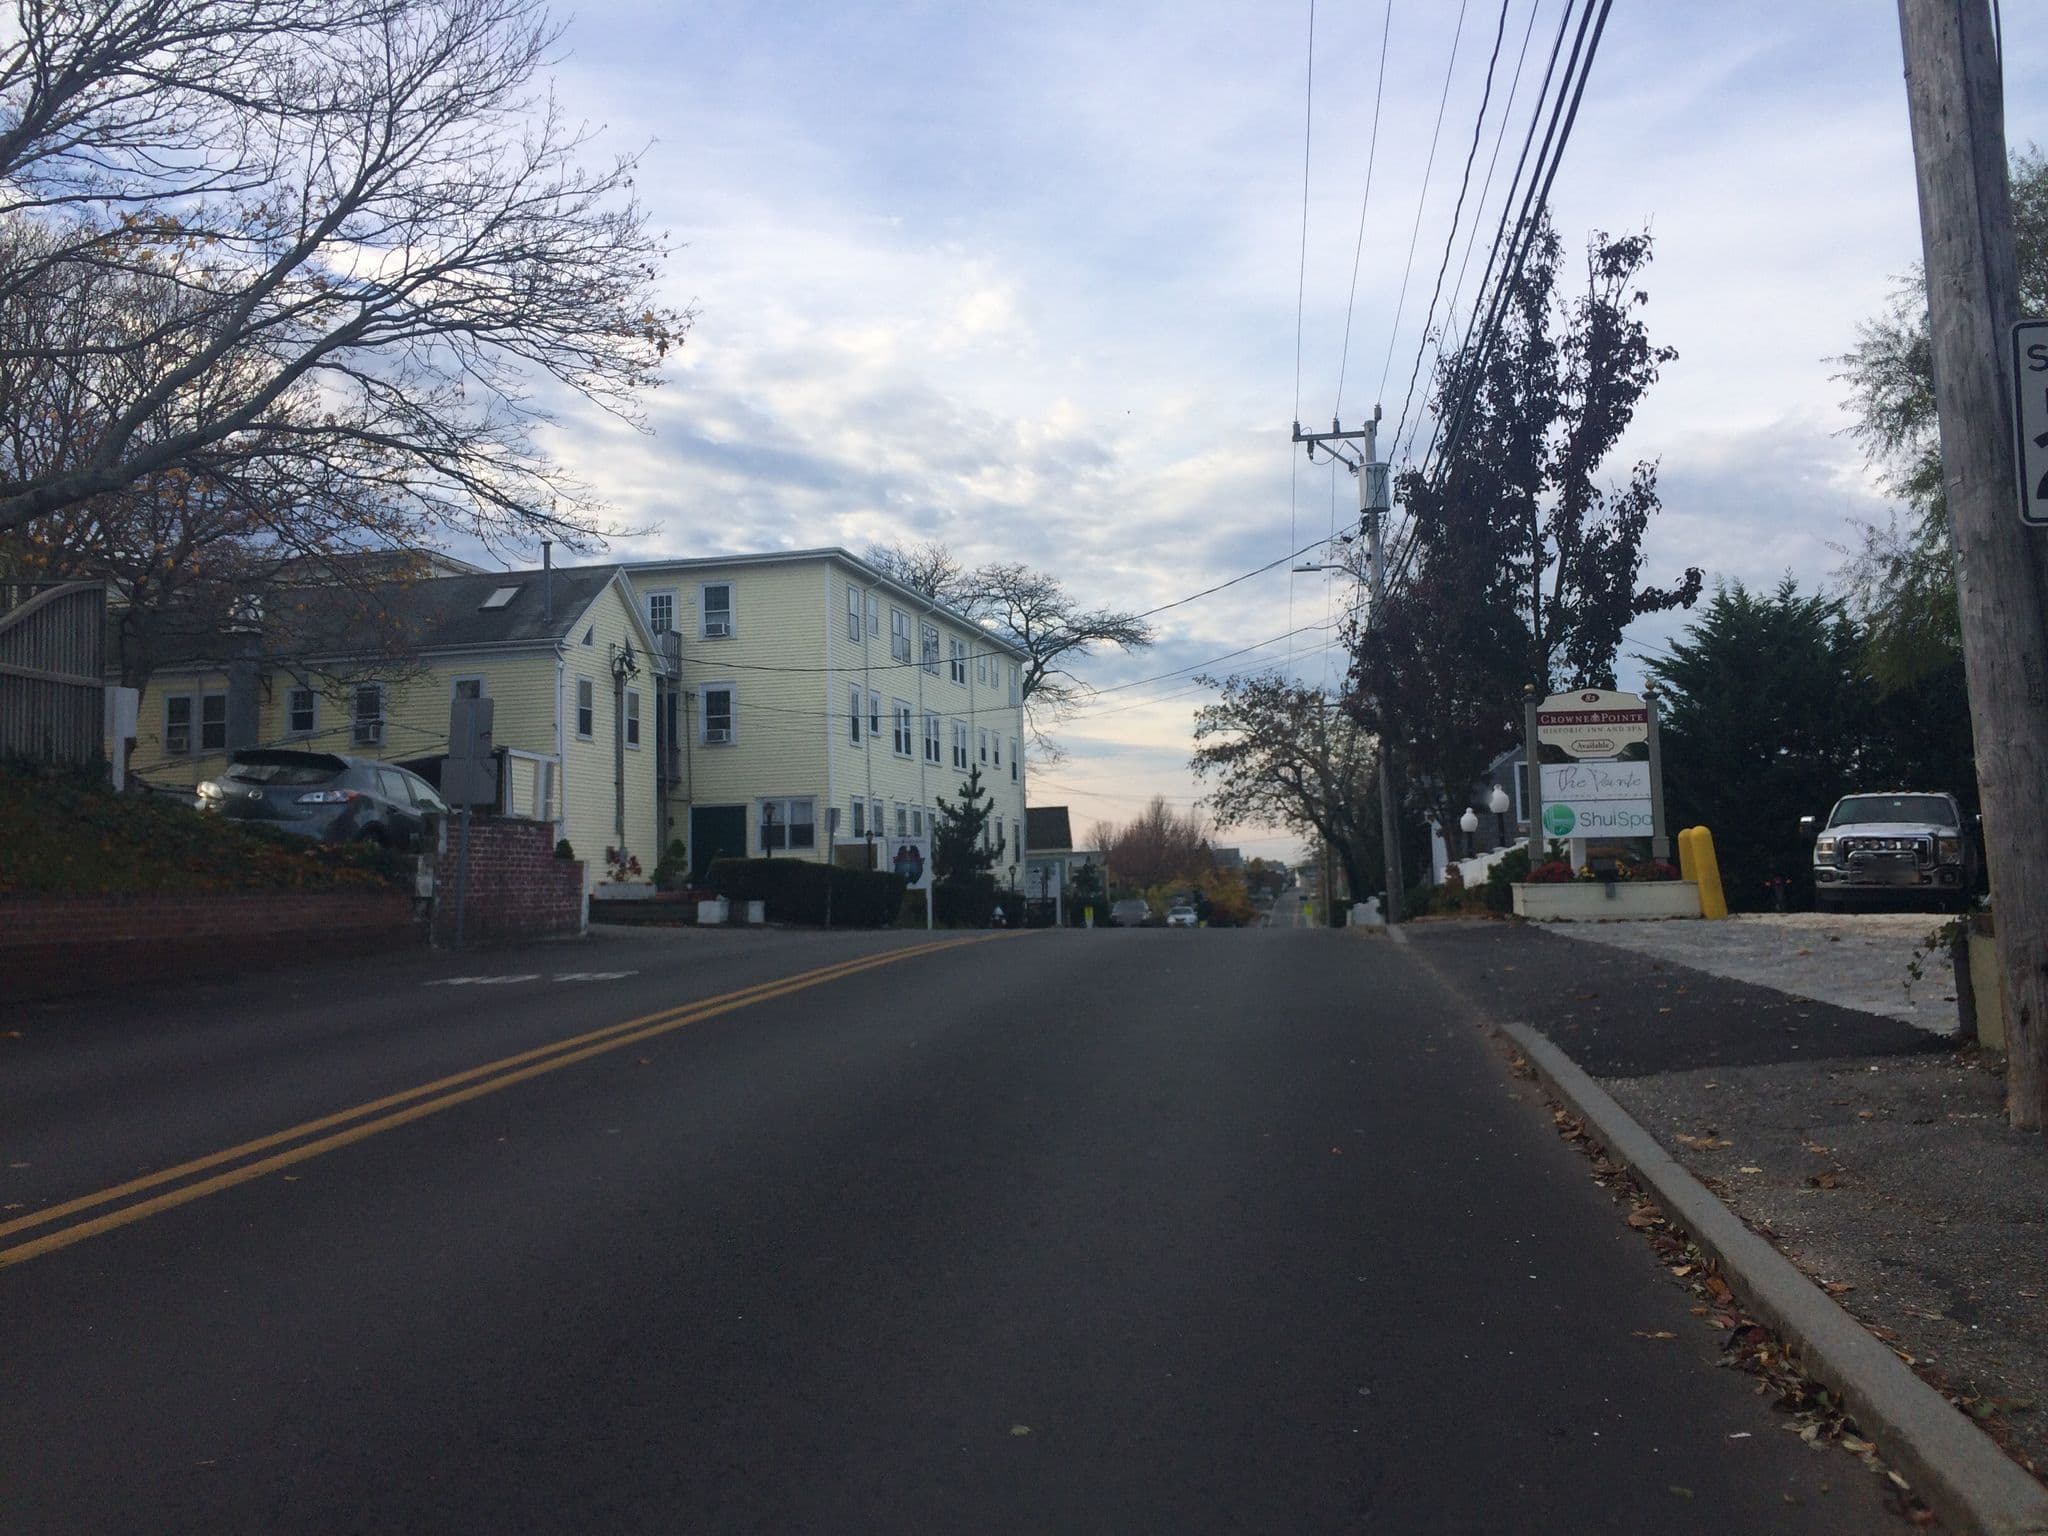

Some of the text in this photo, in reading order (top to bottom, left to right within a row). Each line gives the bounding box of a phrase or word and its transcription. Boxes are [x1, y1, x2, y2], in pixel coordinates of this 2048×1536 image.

[1540, 713, 1644, 724] CROWNE POINTE
[1543, 726, 1585, 735] HISTORIC
[1587, 726, 1602, 734] INN
[1607, 725, 1625, 733] AND
[1577, 740, 1610, 749] Available
[1545, 766, 1586, 792] The
